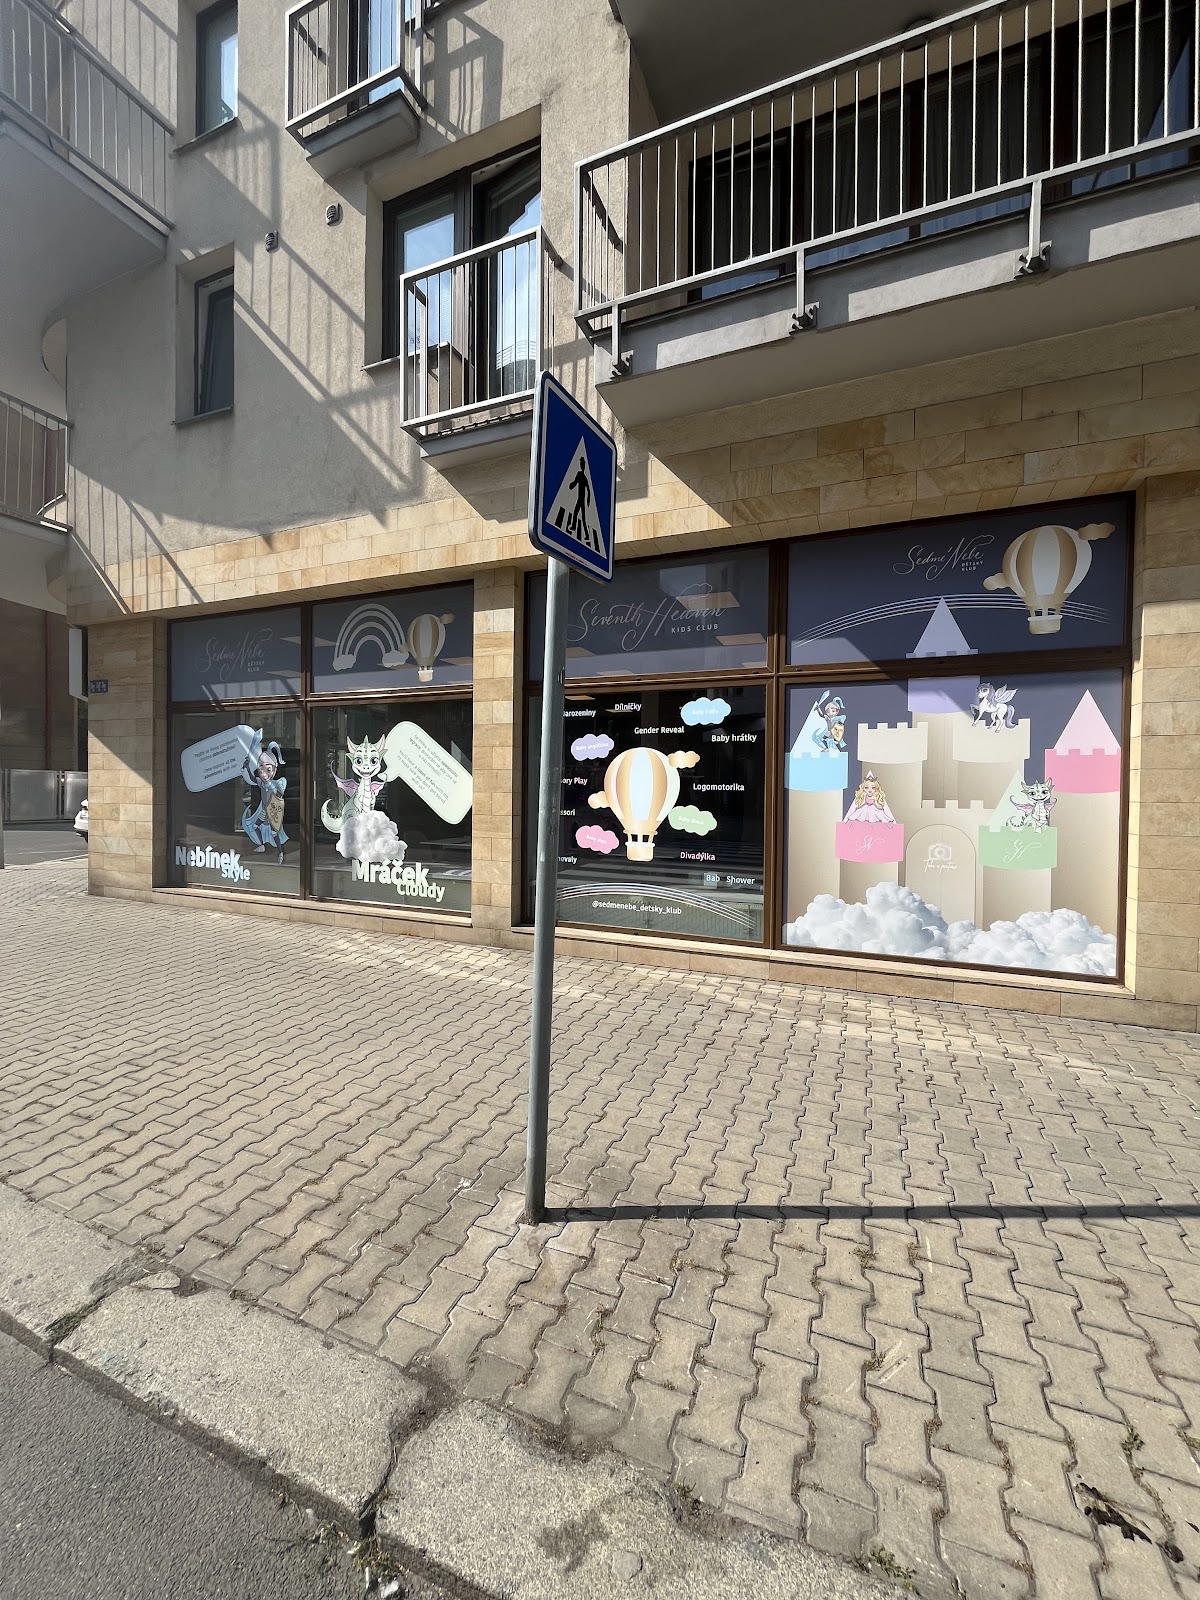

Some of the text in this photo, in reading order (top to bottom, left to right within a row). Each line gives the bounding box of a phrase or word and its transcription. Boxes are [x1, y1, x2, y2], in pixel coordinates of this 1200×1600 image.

[567, 583, 728, 651] Seventh Heaven
[671, 623, 719, 634] KIDS CLUB
[633, 725, 685, 735] Gender Reveal
[711, 732, 758, 744] Baby hrátky
[573, 776, 588, 786] Play
[693, 782, 745, 792] Logomotorika
[175, 845, 242, 869] Nebínek
[680, 851, 716, 861] Divadýlka
[351, 858, 430, 887] Mráček
[726, 875, 756, 885] Shower
[396, 880, 446, 903] Cloudy
[592, 900, 682, 915] @sedmenebe_detsky_klub
